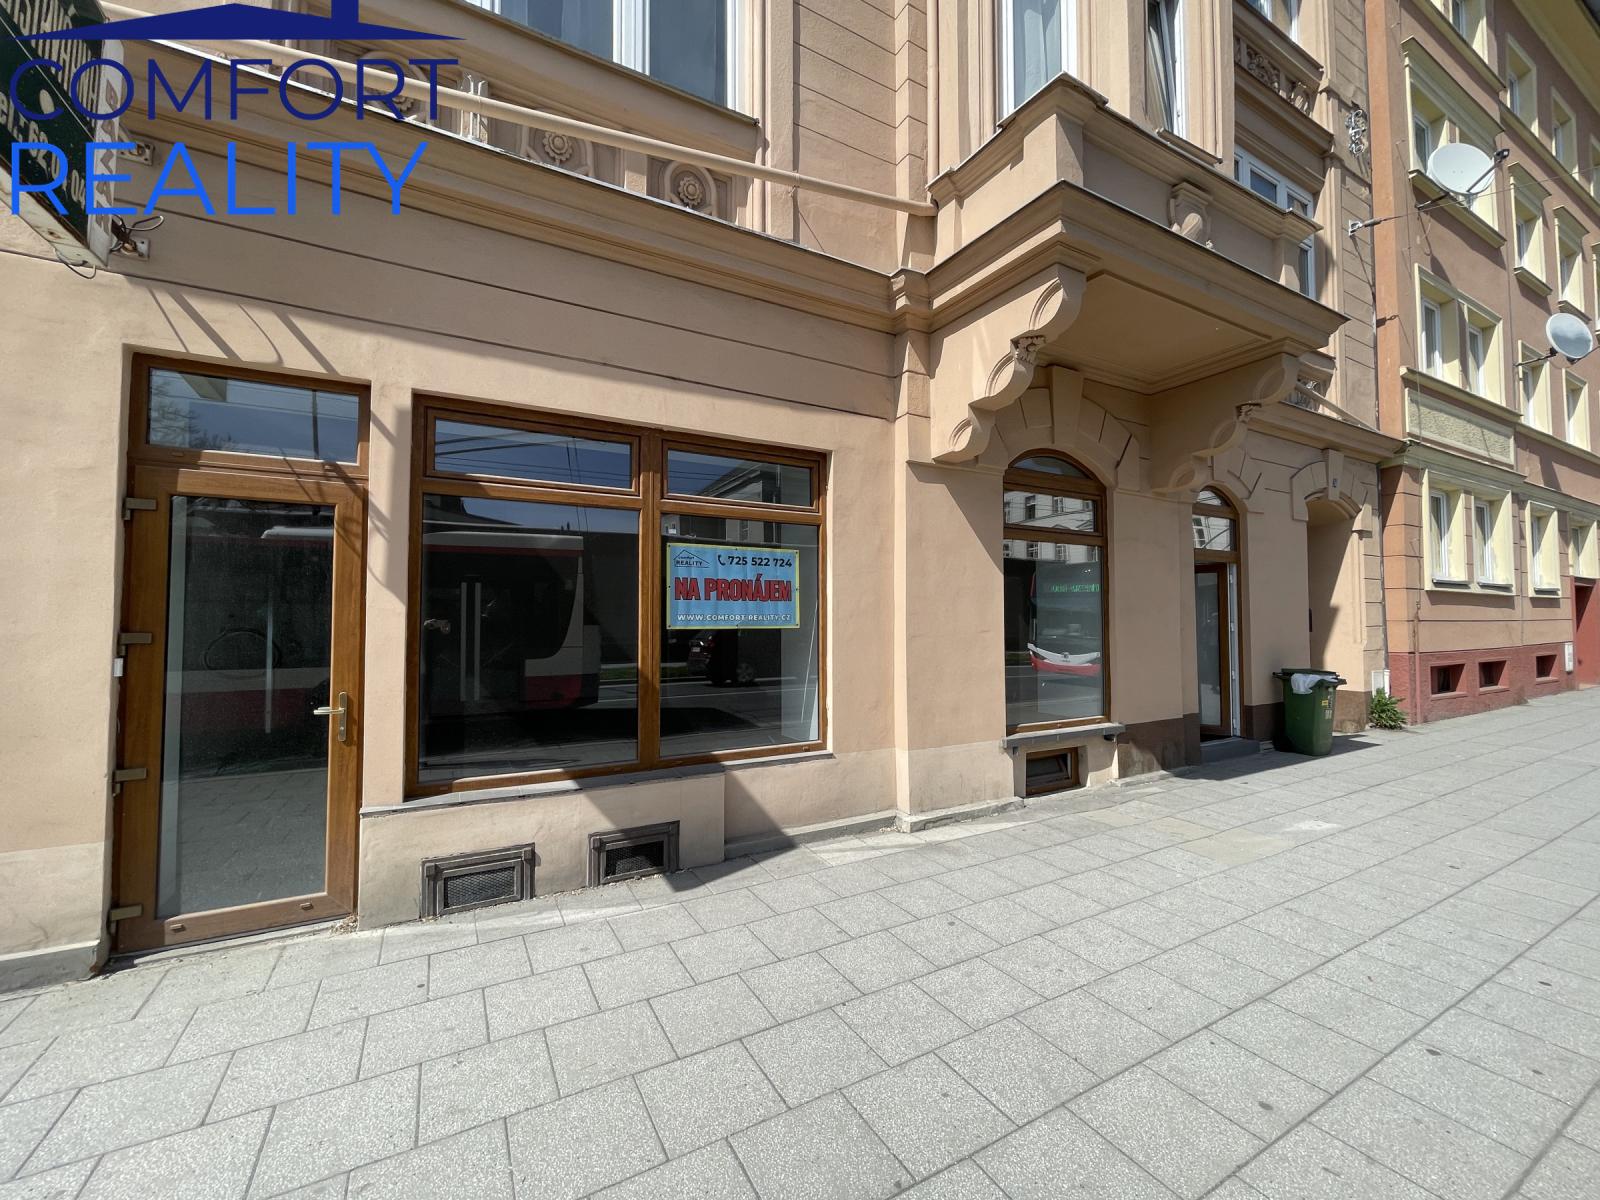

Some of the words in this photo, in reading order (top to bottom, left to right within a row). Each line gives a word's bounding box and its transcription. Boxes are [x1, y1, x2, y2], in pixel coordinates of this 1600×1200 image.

[727, 555, 748, 566] 725
[751, 557, 770, 567] 522
[773, 558, 793, 568] 724
[674, 577, 701, 601] NA
[704, 573, 792, 602] PRONÁJEM
